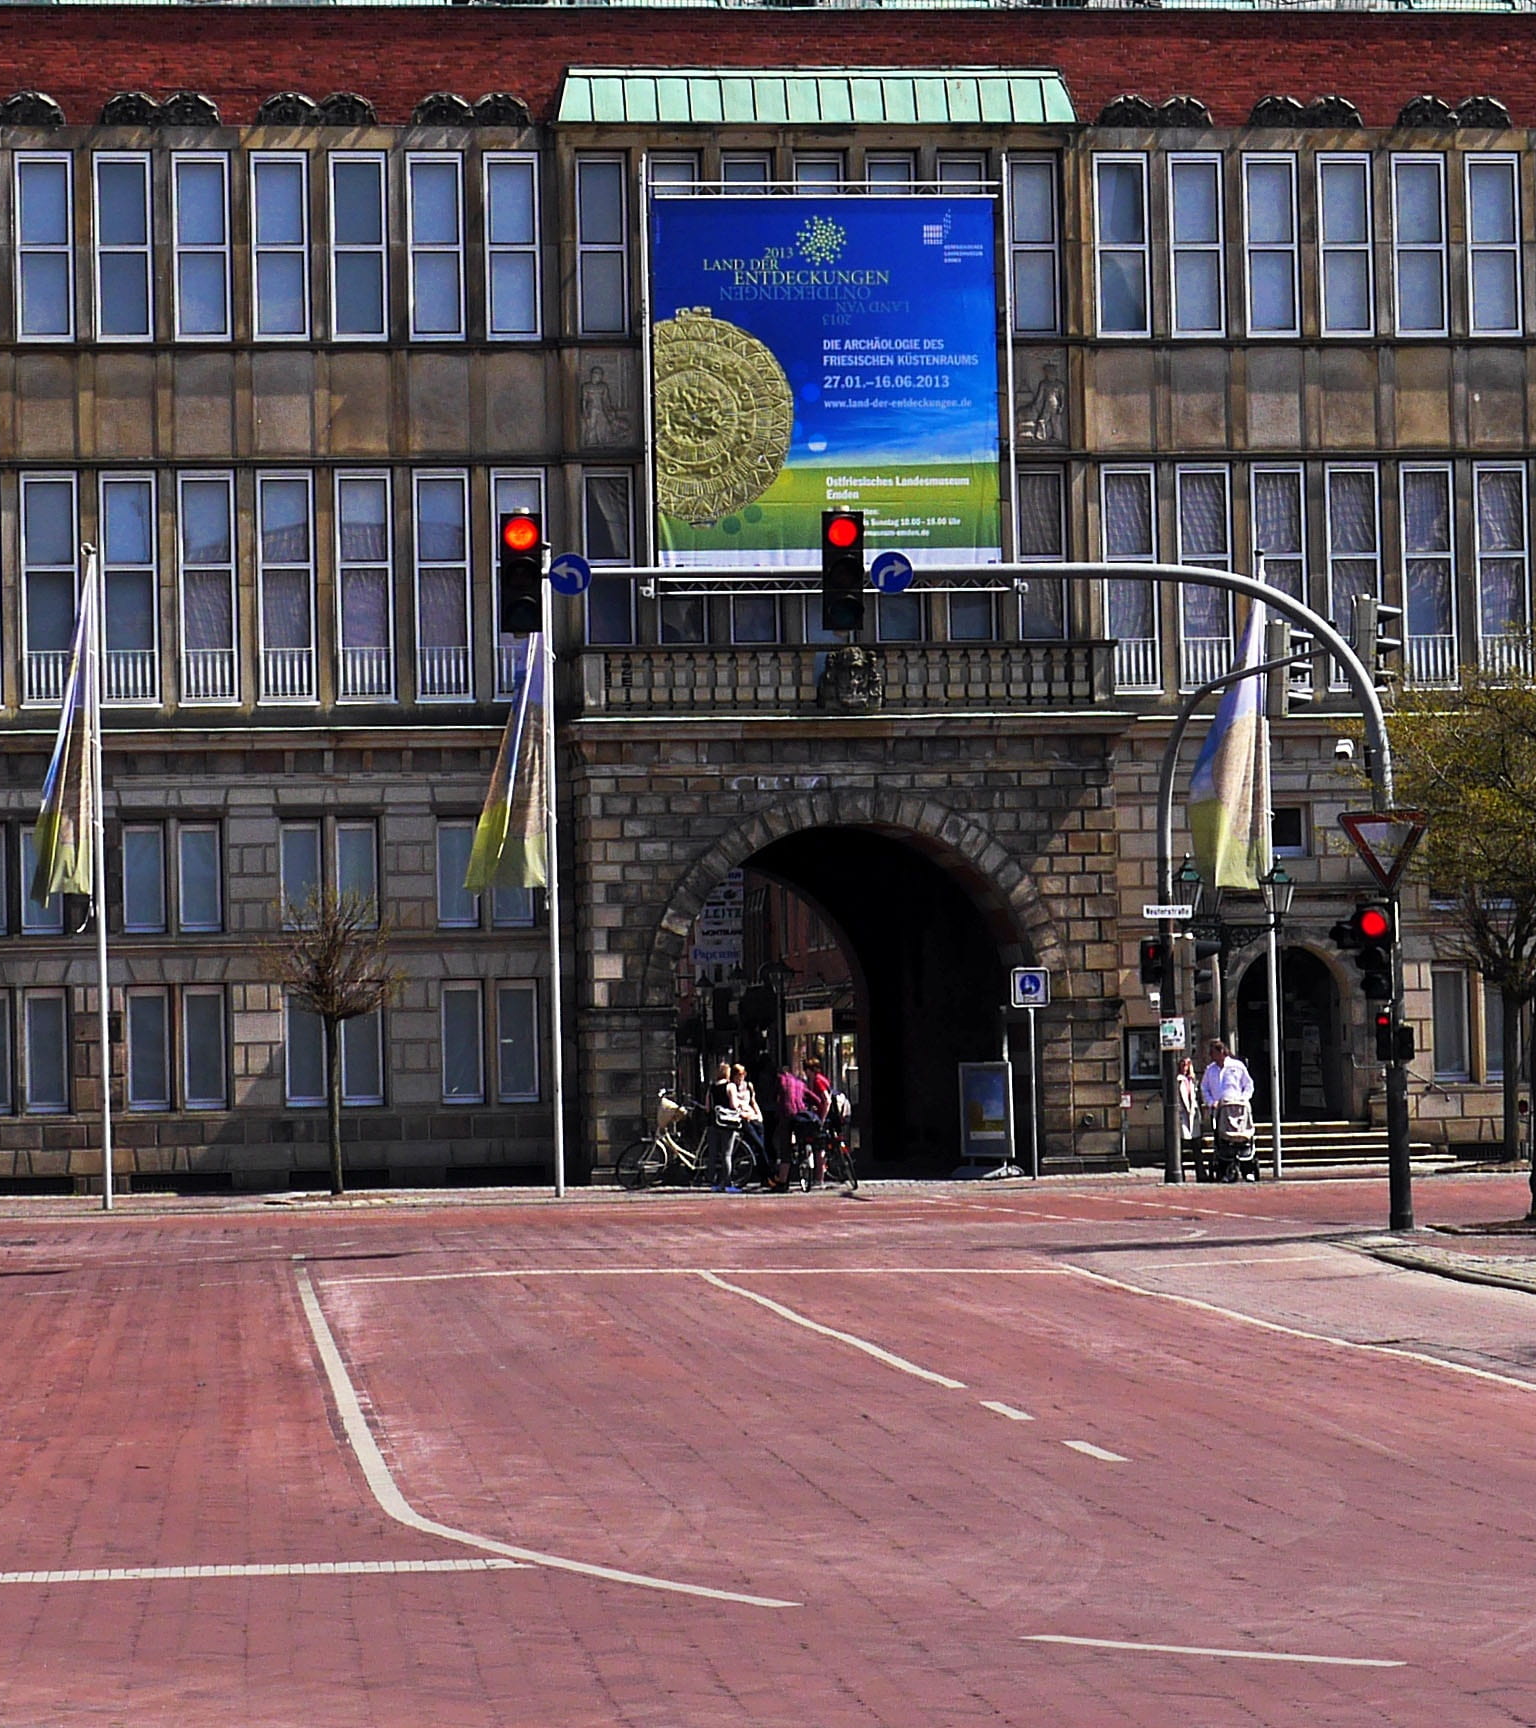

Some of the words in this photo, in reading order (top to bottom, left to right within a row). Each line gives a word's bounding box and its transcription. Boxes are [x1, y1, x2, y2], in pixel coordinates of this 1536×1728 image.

[764, 248, 794, 259] 2013
[704, 259, 745, 270] LAND
[750, 259, 779, 270] DER
[734, 271, 890, 285] ENTDECKUNGEN
[823, 339, 842, 351] DIE
[844, 337, 921, 351] ARCHÄOLOGIE
[923, 339, 944, 350] DES
[823, 355, 894, 367] FRIESISCHEN
[897, 352, 979, 366] KÜSTENRAUMS
[824, 398, 972, 409] www.land-der-entdeckungen.de
[826, 476, 894, 487] Ostfriesisches
[896, 476, 970, 486] Landesmuseum
[826, 489, 860, 500] Emden
